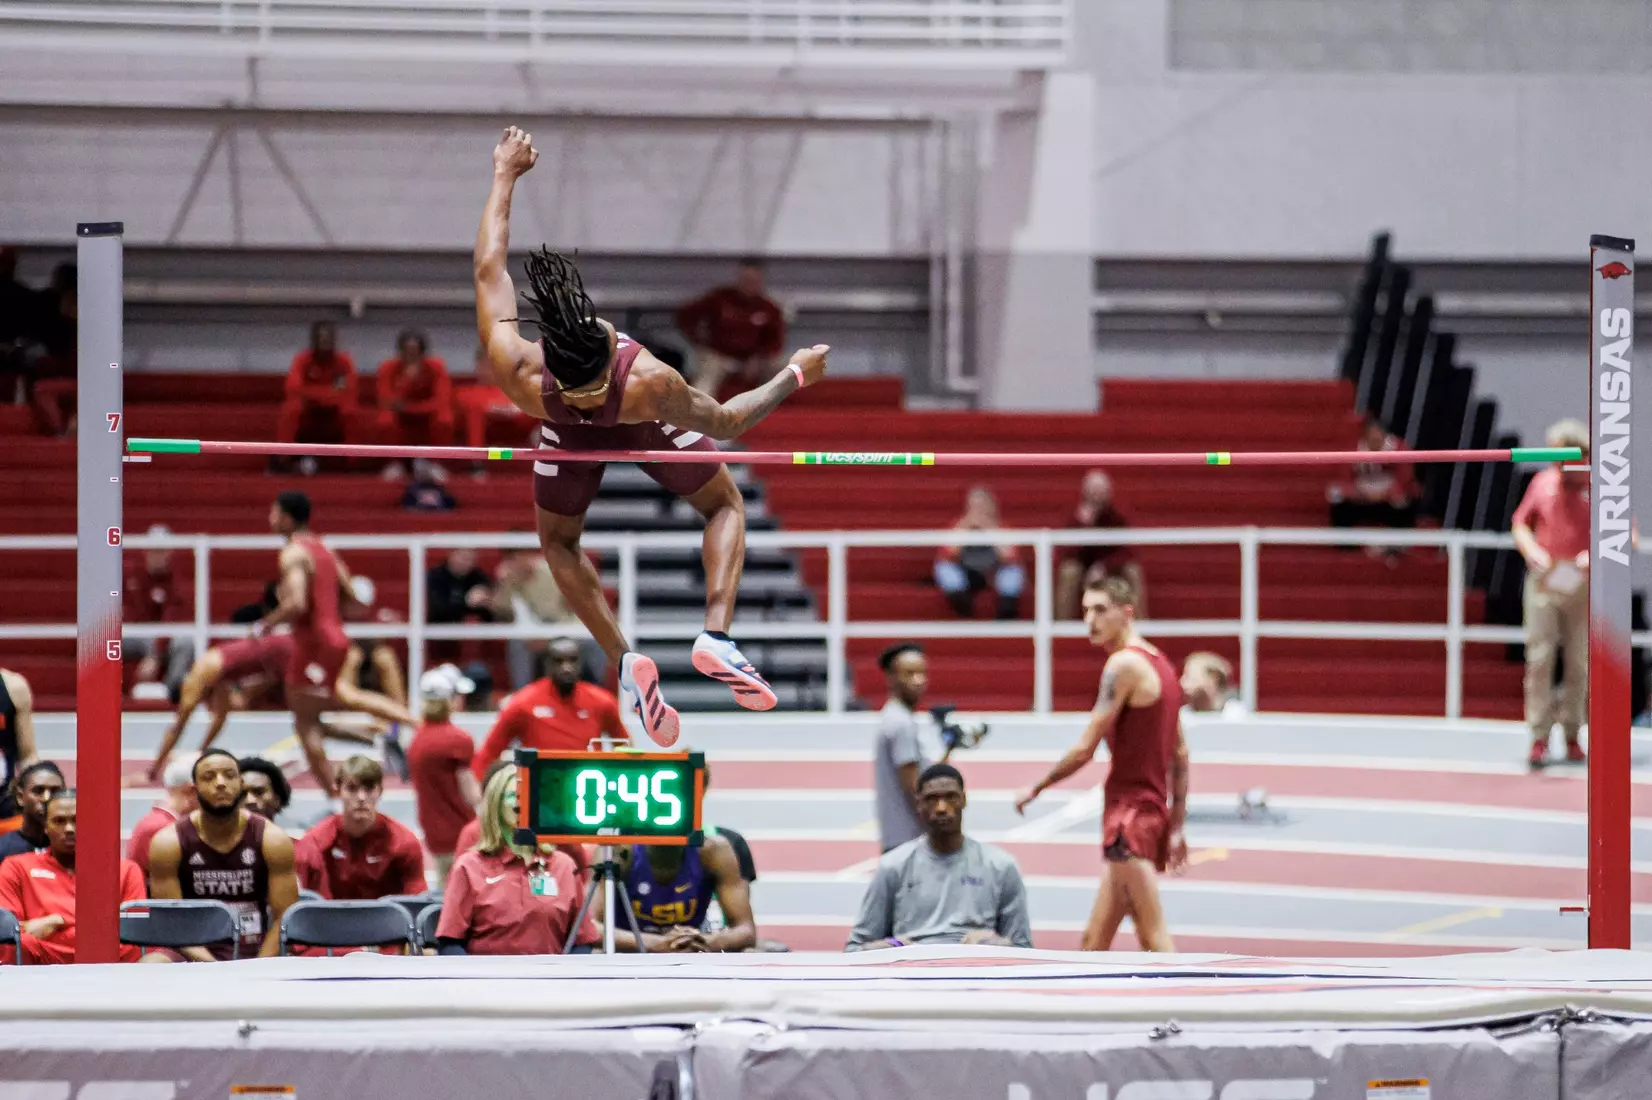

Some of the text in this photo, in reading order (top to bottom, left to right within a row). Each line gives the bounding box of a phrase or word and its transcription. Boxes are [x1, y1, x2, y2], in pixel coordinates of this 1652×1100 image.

[106, 413, 121, 433] 7
[1599, 307, 1632, 567] ARKANSAS
[106, 527, 121, 547] 6
[106, 640, 121, 660] 5
[575, 768, 682, 826] 0:45
[193, 881, 255, 896] STATE
[632, 898, 698, 925] LSU
